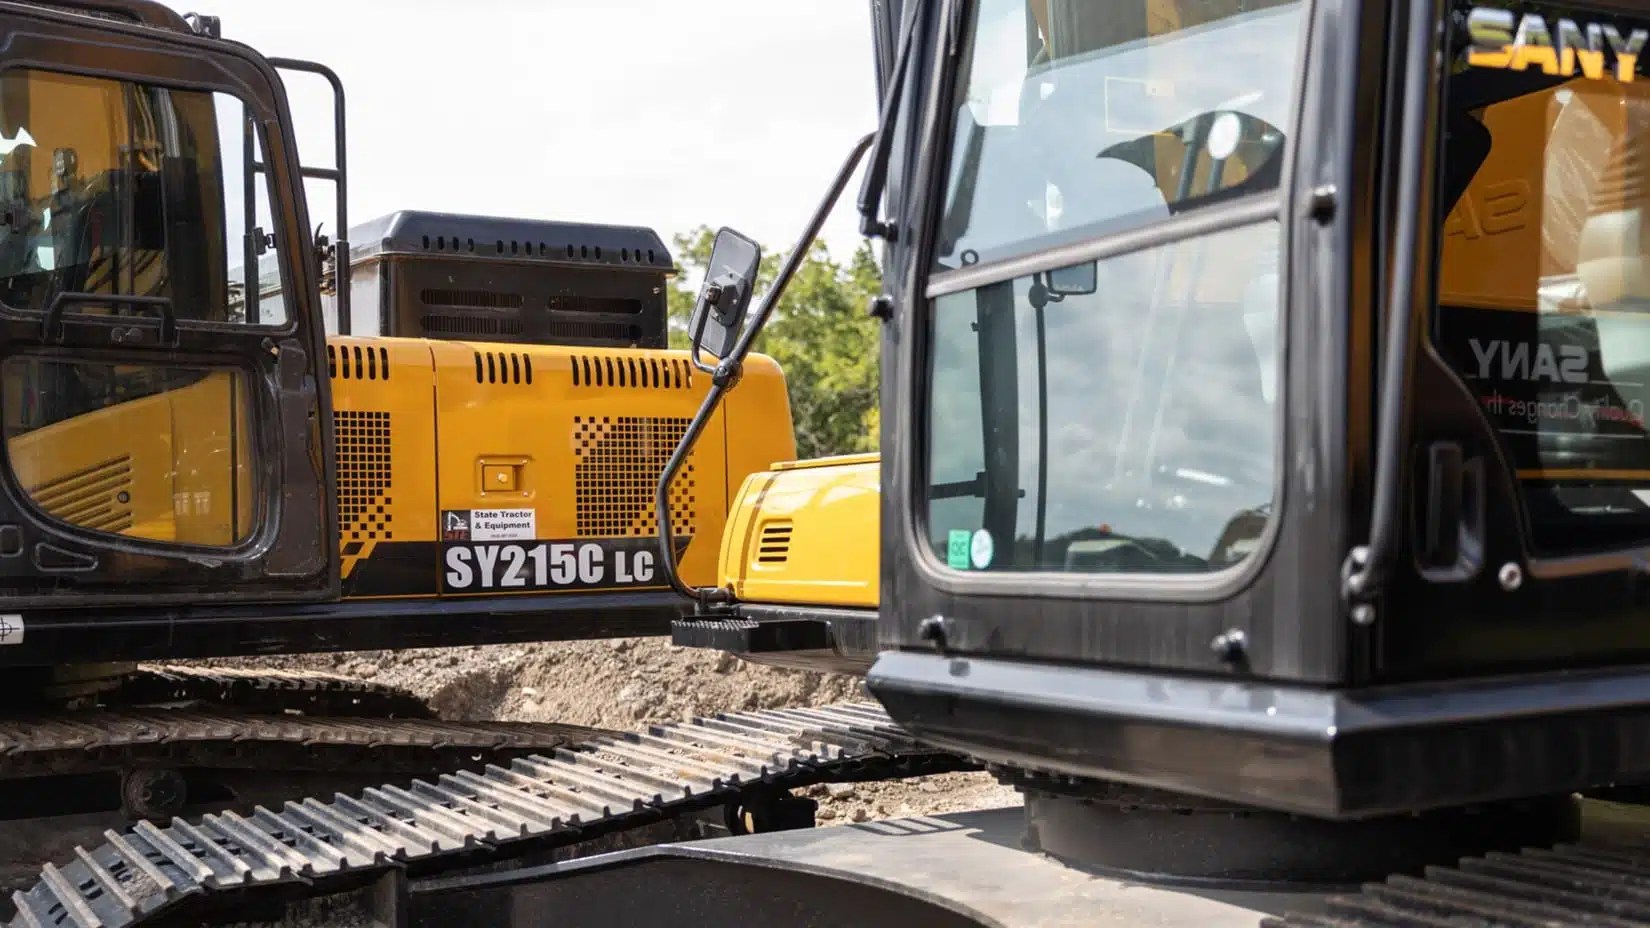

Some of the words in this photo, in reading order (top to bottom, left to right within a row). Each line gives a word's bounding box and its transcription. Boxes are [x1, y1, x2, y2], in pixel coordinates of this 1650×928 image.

[1467, 7, 1649, 83] SANY
[484, 521, 530, 530] Equipment
[446, 543, 604, 588] SY215C
[615, 551, 654, 583] LC
